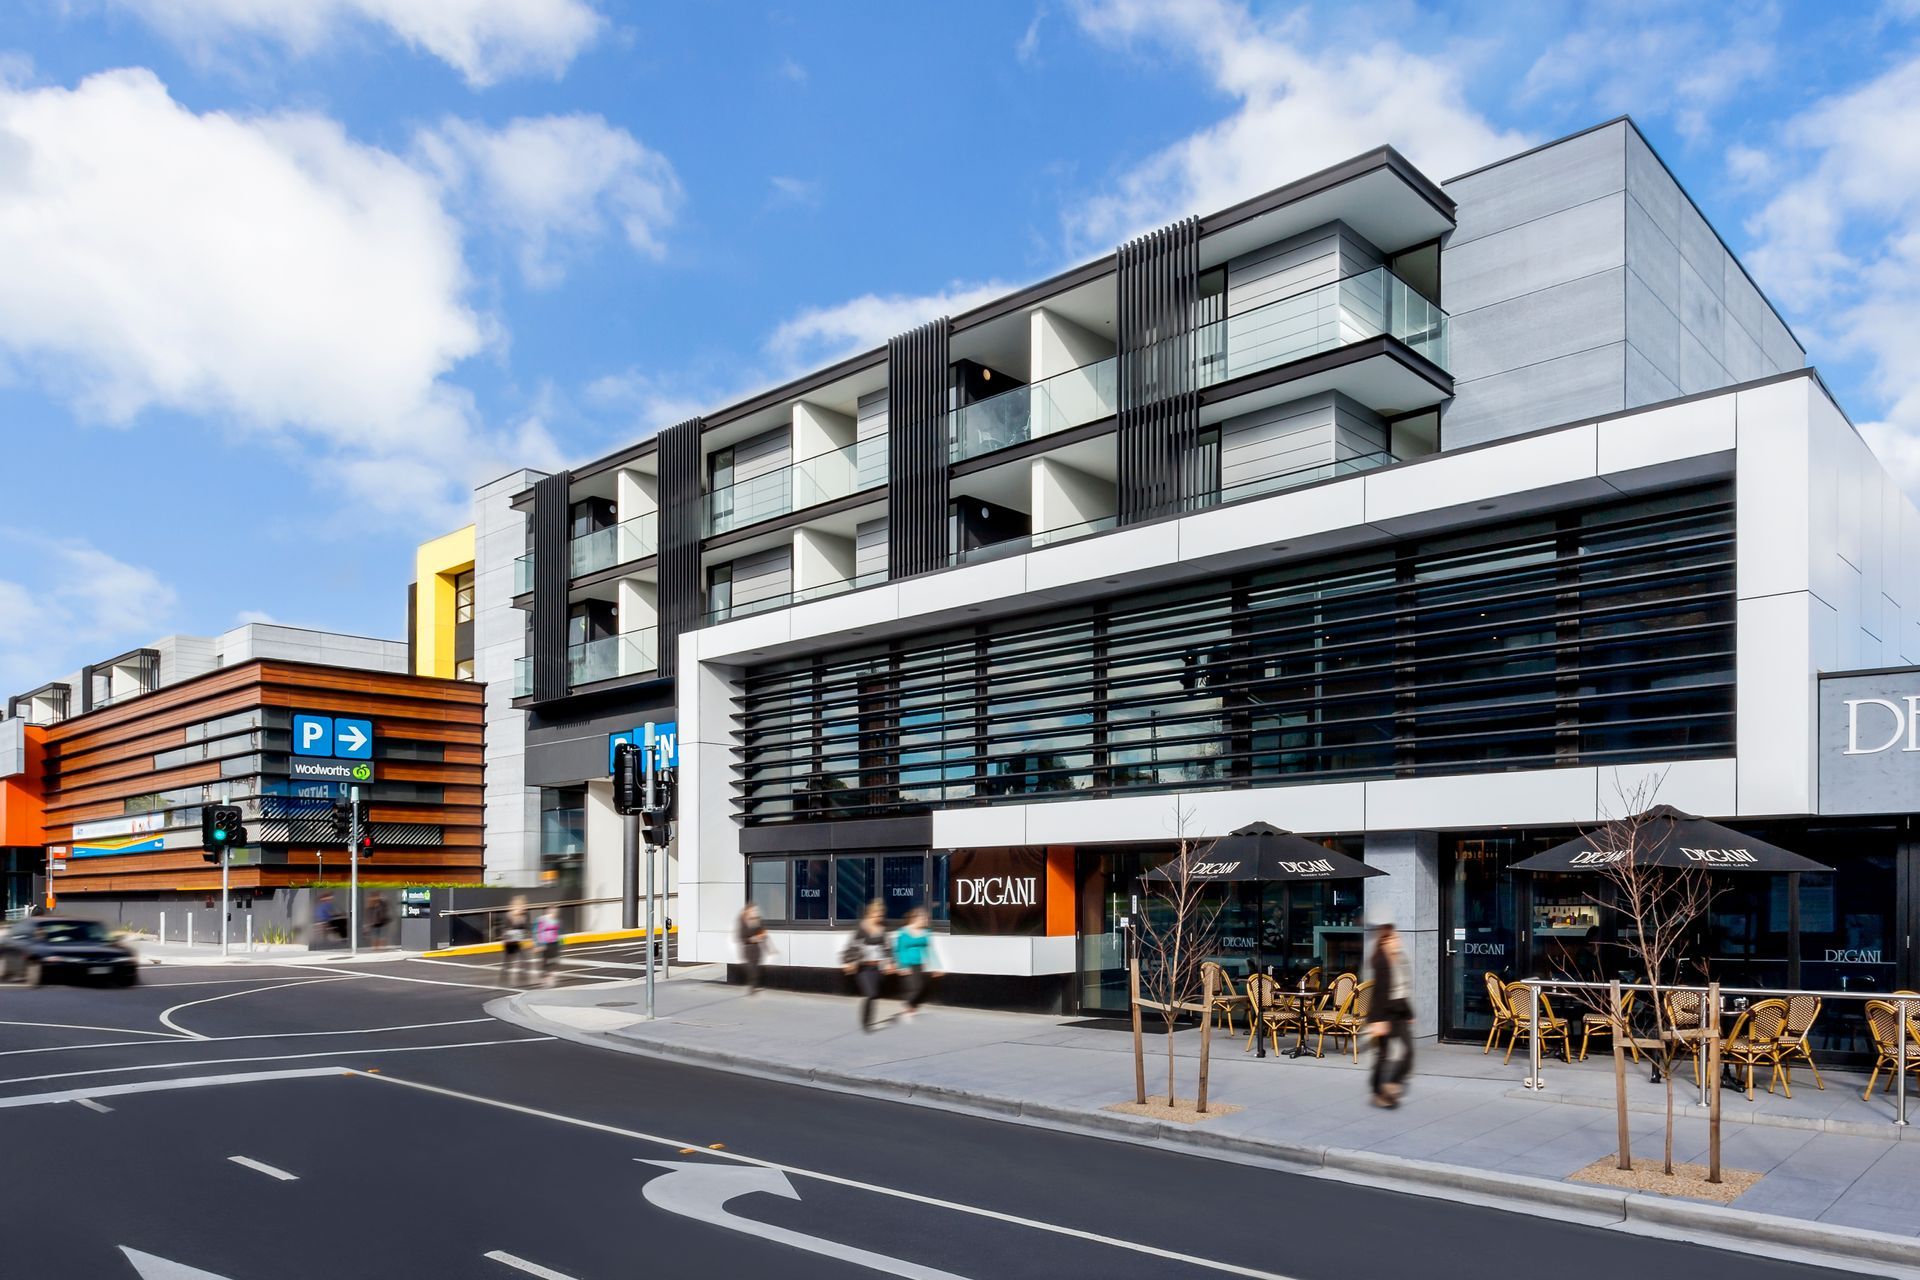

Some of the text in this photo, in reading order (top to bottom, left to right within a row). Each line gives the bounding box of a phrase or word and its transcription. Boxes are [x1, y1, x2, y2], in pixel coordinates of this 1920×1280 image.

[303, 722, 323, 749] P
[295, 763, 351, 777] Woolworths
[1679, 847, 1758, 863] DEGANI
[1188, 861, 1241, 875] DEGANI
[1278, 858, 1336, 873] DEGANI
[956, 876, 1037, 907] DEGANI
[1223, 936, 1255, 948] DEGANI
[1464, 942, 1505, 956] DEGANI
[1824, 949, 1882, 964] DEGANI
